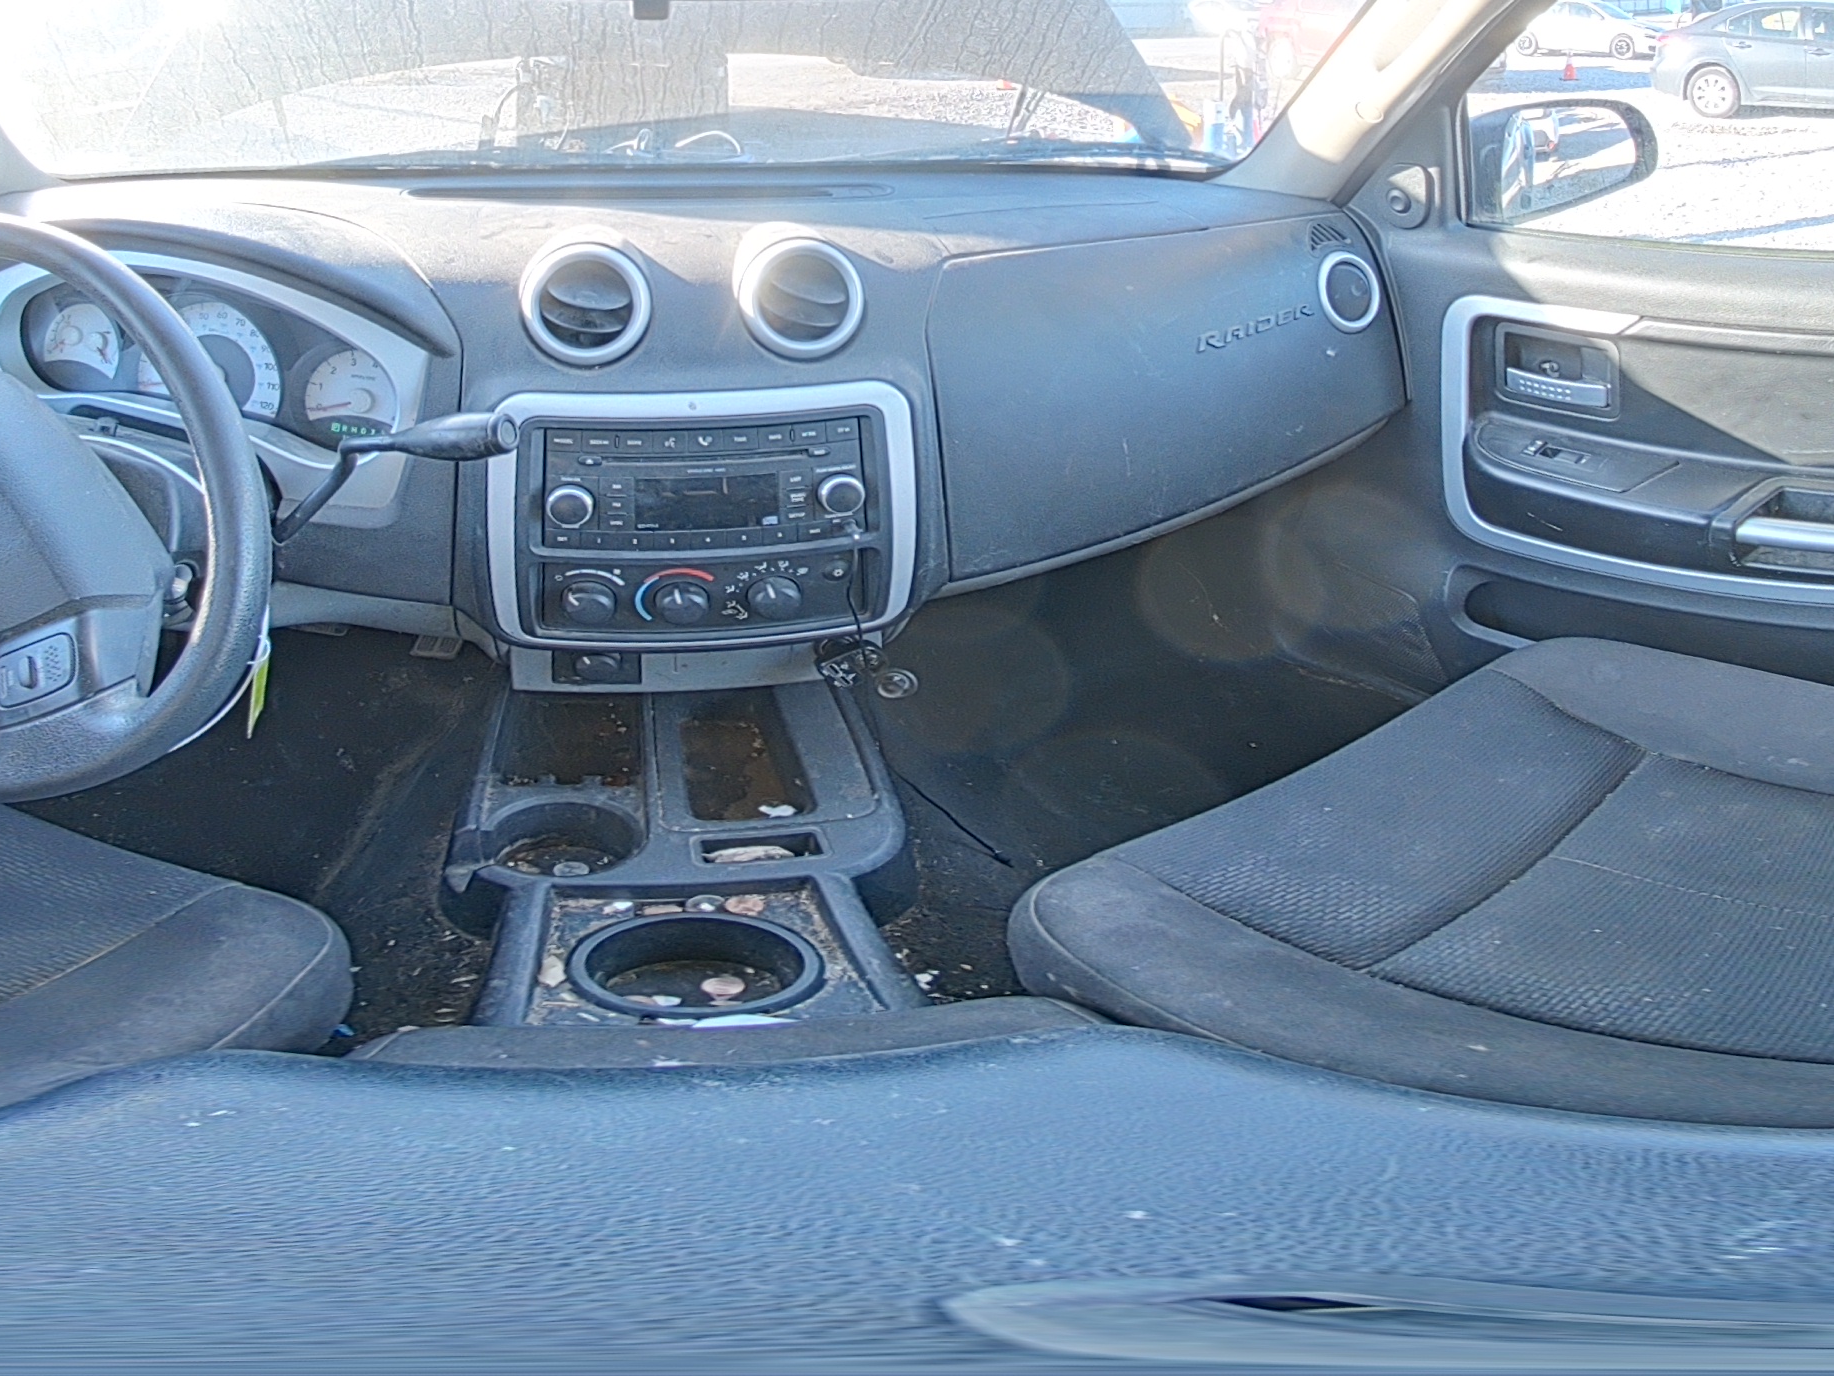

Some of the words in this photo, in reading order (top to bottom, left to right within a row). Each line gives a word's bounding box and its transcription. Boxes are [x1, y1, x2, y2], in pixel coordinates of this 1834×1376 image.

[199, 312, 209, 320] 50
[217, 311, 228, 320] 60
[235, 318, 246, 326] 70
[1196, 303, 1315, 353] RAIDER
